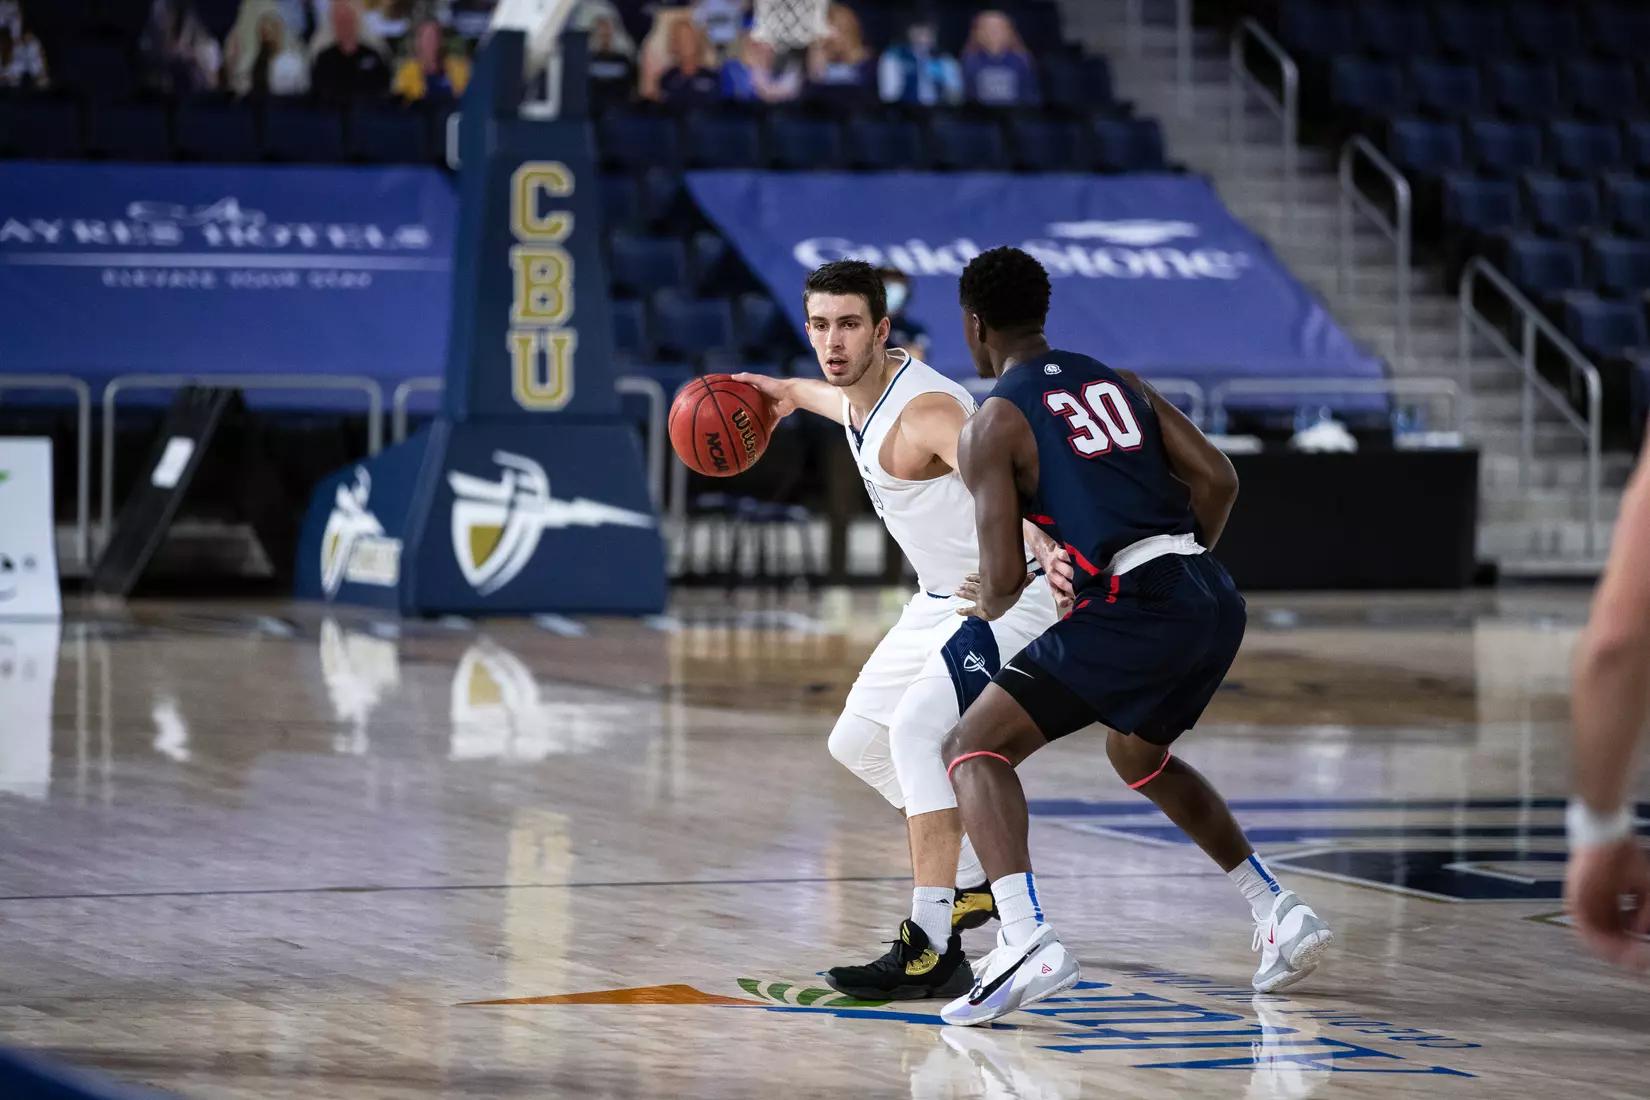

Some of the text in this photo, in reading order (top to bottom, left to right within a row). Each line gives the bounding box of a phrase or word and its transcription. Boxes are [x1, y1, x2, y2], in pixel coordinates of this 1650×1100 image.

[506, 160, 579, 413] CBU
[1043, 379, 1144, 459] 30
[1275, 1009, 1483, 1049] CREDIT
